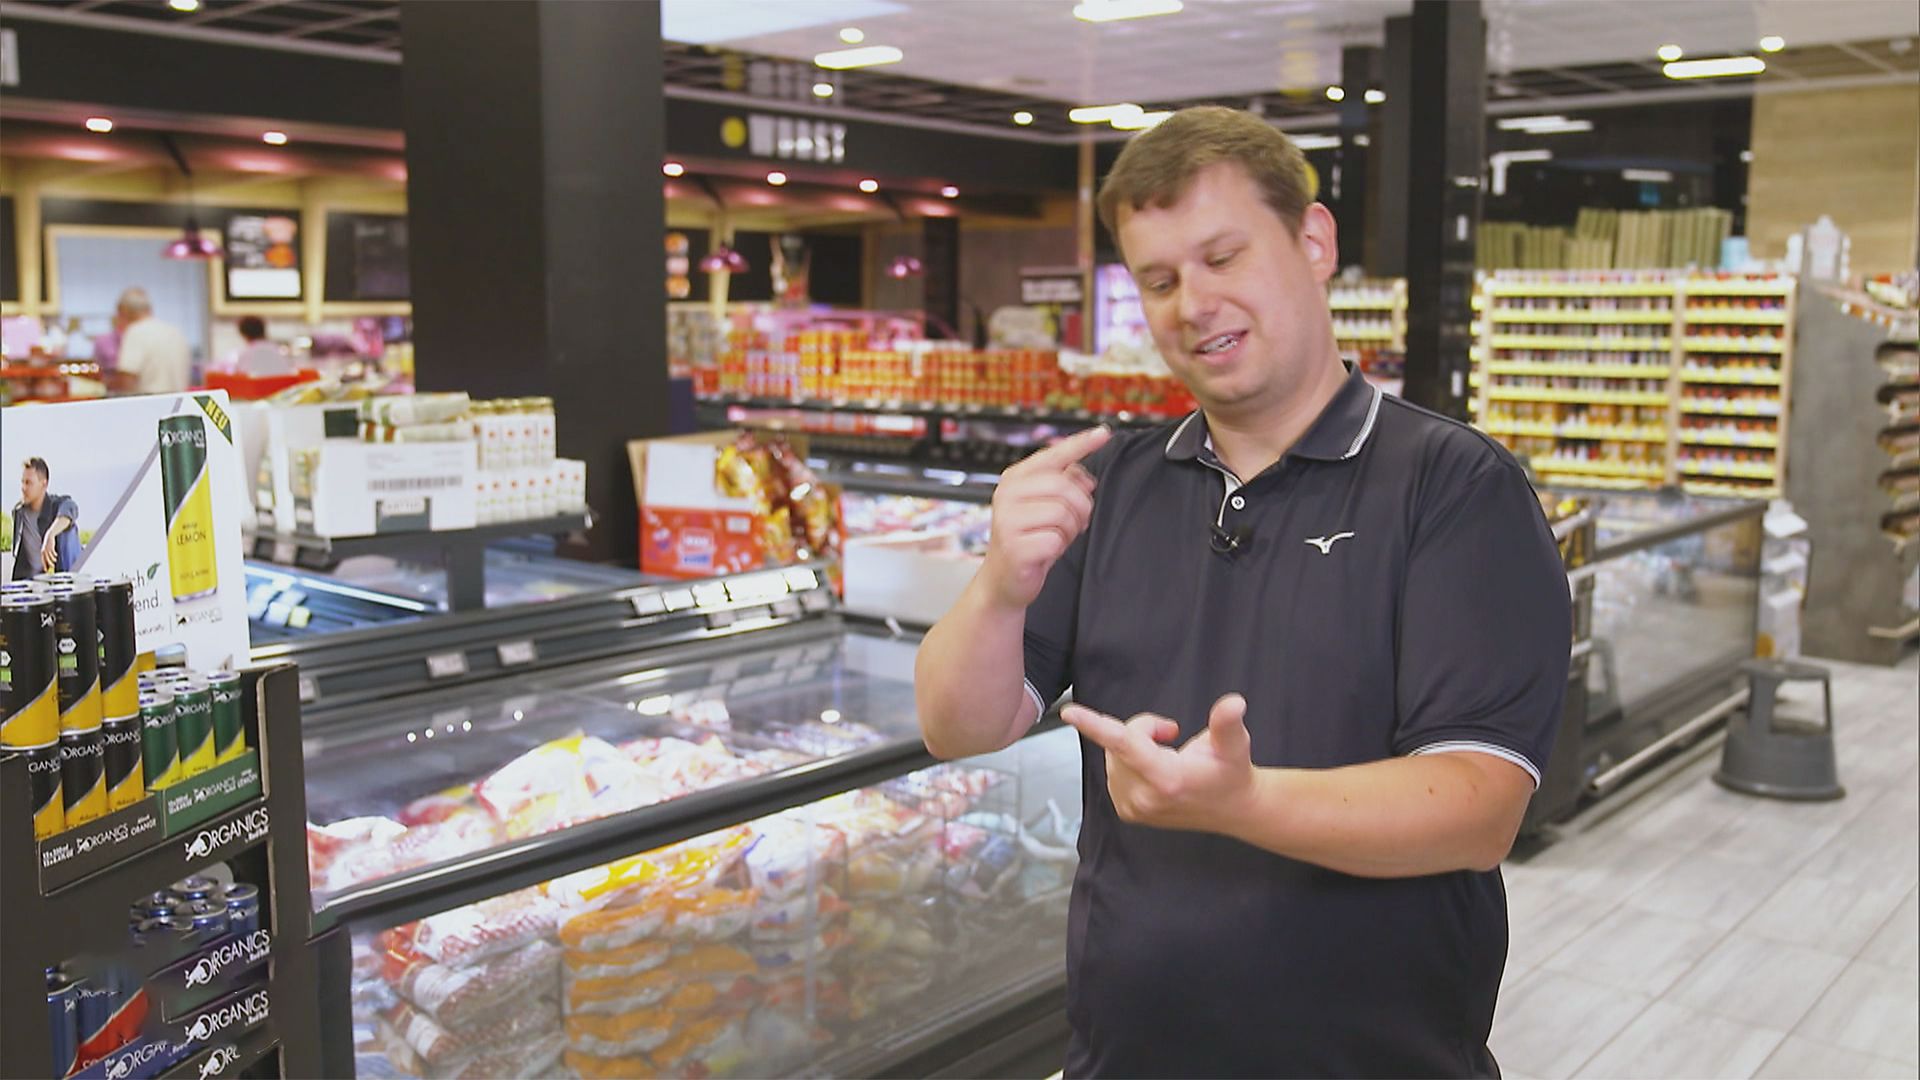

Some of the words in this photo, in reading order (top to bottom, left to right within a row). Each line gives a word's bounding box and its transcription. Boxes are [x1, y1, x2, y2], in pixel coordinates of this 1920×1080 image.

[205, 398, 230, 431] NEU
[176, 530, 207, 546] LEMON
[198, 806, 269, 857] ORGANICS
[198, 990, 269, 1042] ORGANICS
